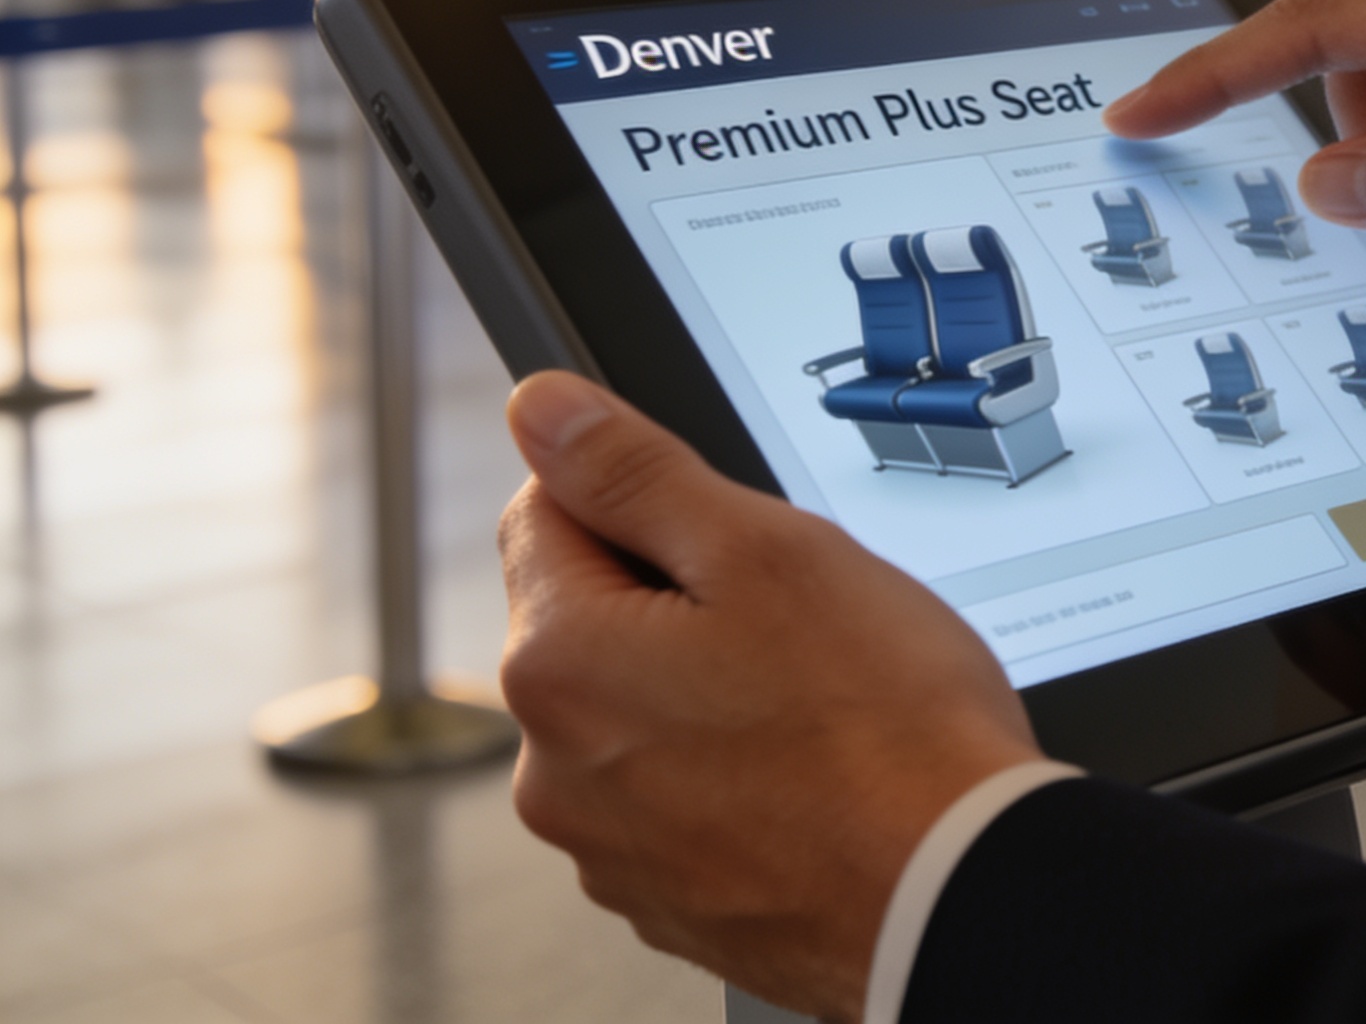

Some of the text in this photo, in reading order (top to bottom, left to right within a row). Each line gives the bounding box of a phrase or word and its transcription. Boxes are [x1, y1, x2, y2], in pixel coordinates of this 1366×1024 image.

[578, 27, 775, 79] Denver
[621, 73, 1103, 172] Premium Plus Seat
